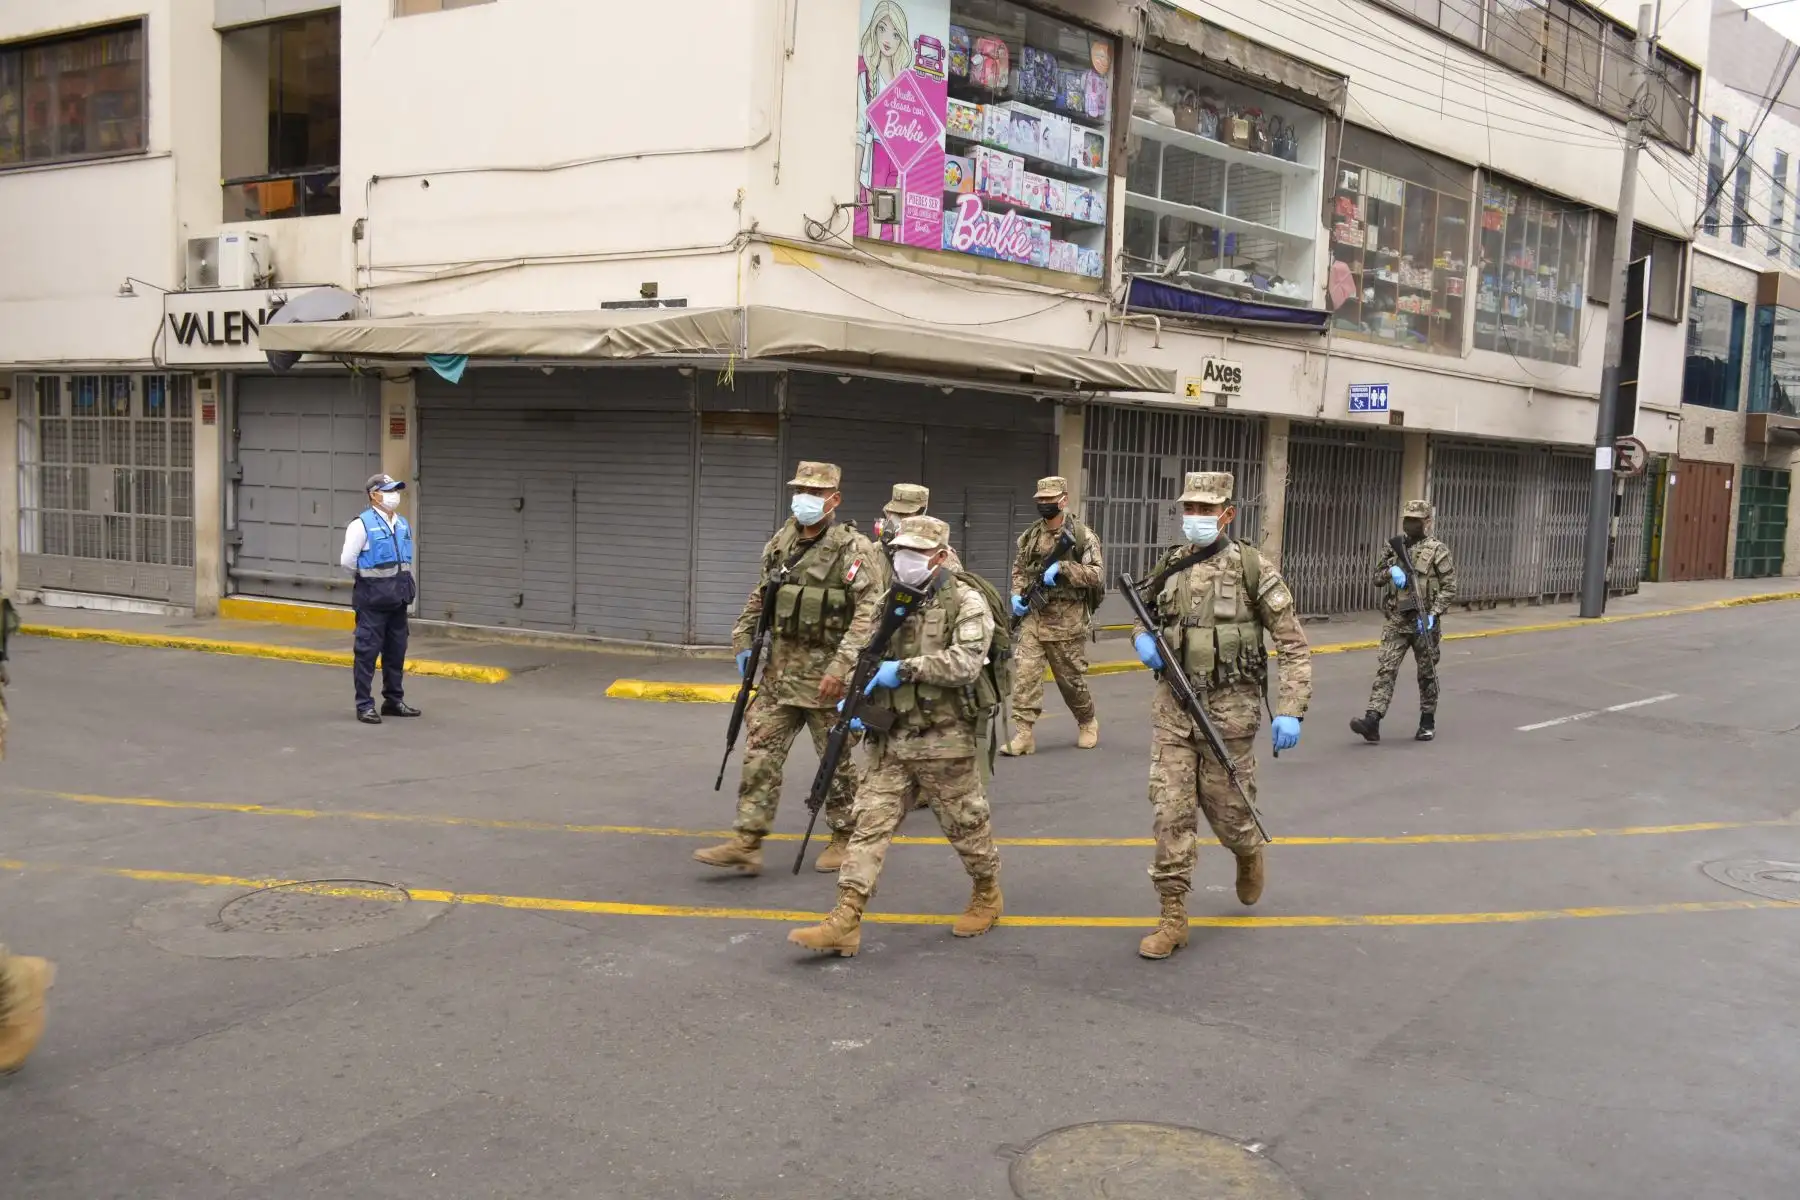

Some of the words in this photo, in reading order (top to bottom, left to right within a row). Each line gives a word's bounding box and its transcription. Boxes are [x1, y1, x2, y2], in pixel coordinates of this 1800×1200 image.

[883, 109, 928, 144] Barbie
[951, 193, 1033, 258] Barbie
[1203, 360, 1242, 384] Axes
